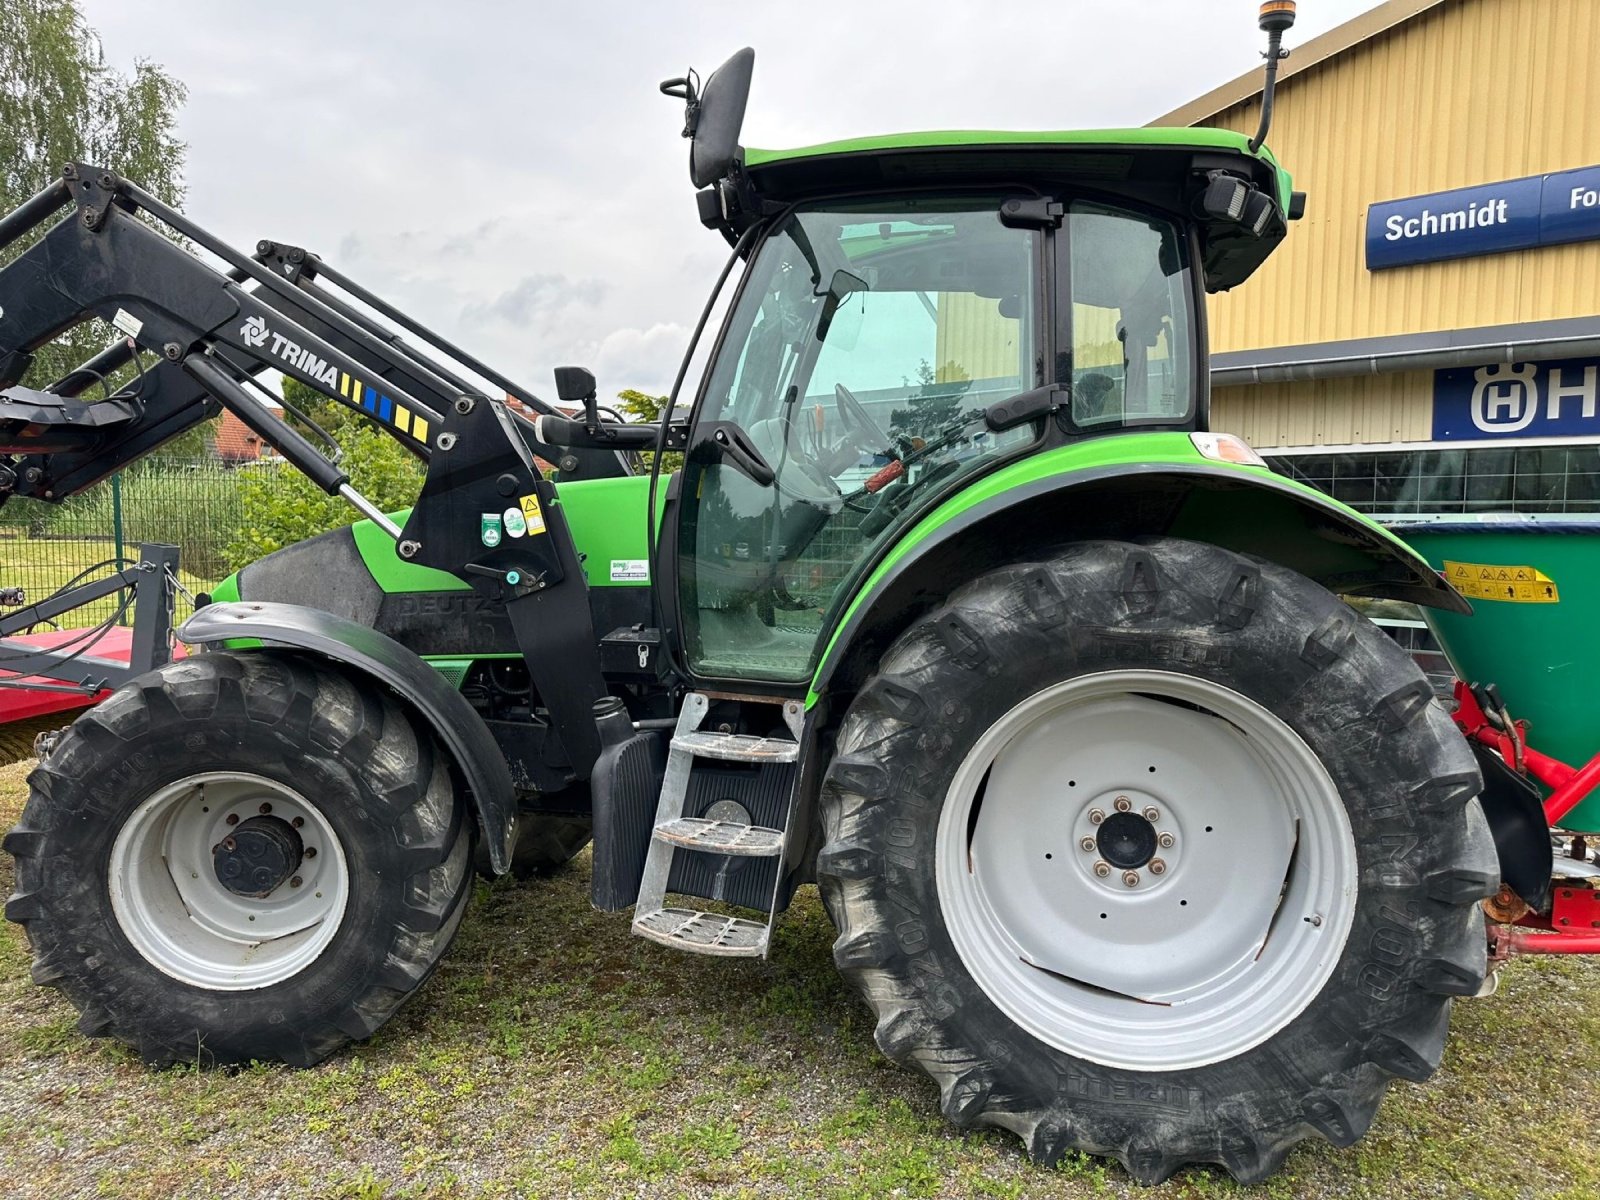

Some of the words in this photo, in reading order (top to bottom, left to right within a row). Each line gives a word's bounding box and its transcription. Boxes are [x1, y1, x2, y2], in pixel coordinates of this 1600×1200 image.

[1570, 187, 1600, 209] Fo
[1385, 199, 1508, 241] Schmidt
[271, 321, 338, 390] TRIMA
